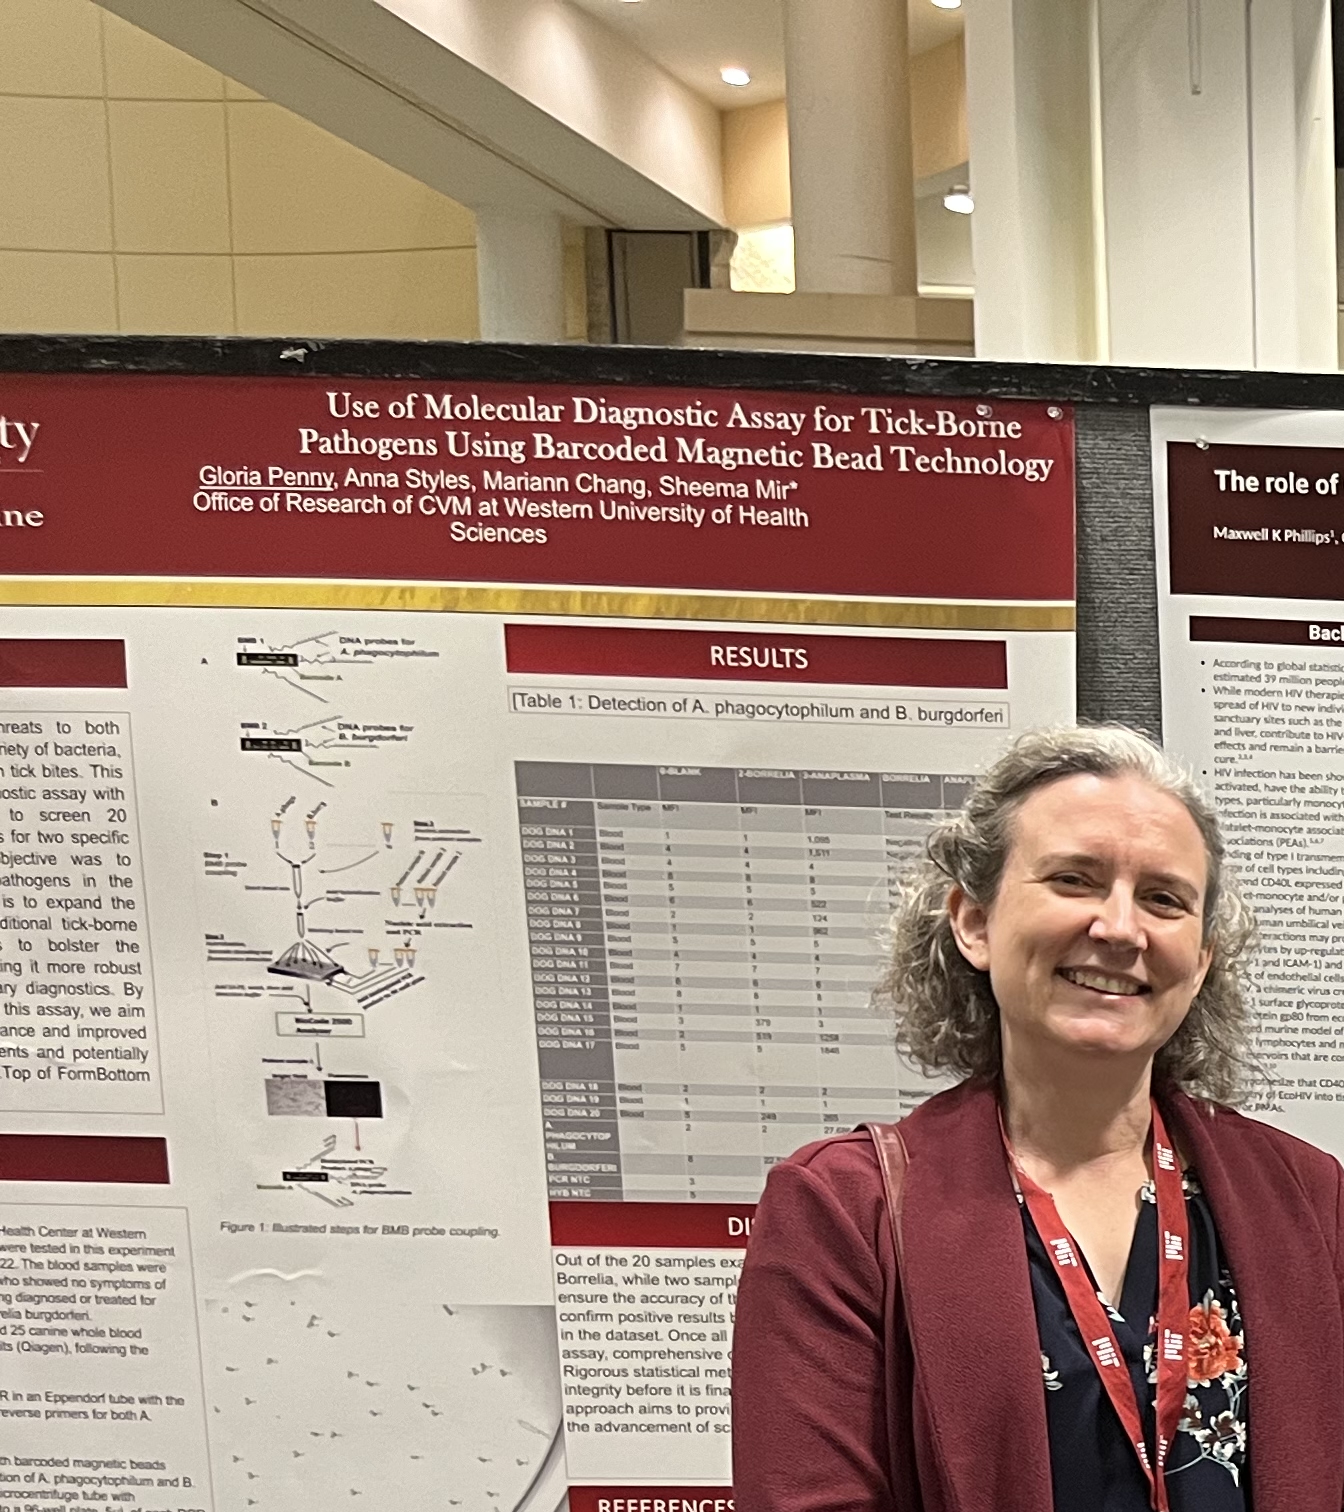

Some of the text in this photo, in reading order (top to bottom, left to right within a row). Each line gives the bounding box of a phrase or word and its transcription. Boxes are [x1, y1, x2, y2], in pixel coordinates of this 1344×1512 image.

[325, 391, 1022, 439] Use of Molecular Diagnostic Assay for Tick-Borne
[298, 428, 1055, 482] Pathogens Using Barcoded Magnetic Bead Technology
[199, 465, 264, 490] Gloria
[263, 466, 339, 492] Penny,
[343, 468, 400, 488] Anna
[405, 469, 477, 494] Styles,
[483, 470, 569, 492] Mariann
[575, 473, 653, 500] Chang,
[659, 475, 749, 499] Sheema
[1213, 469, 1260, 493] The
[1265, 471, 1309, 494] role
[1315, 472, 1340, 495] of
[193, 491, 809, 528] Office of Research of CVM at Western University of Health
[450, 521, 548, 544] Sciences
[710, 645, 809, 669] RESULTS
[588, 694, 667, 713] Detection
[672, 697, 688, 713] of
[714, 699, 855, 720] phagocytophilum
[859, 705, 890, 720] and
[917, 706, 1003, 724] burgdorferi
